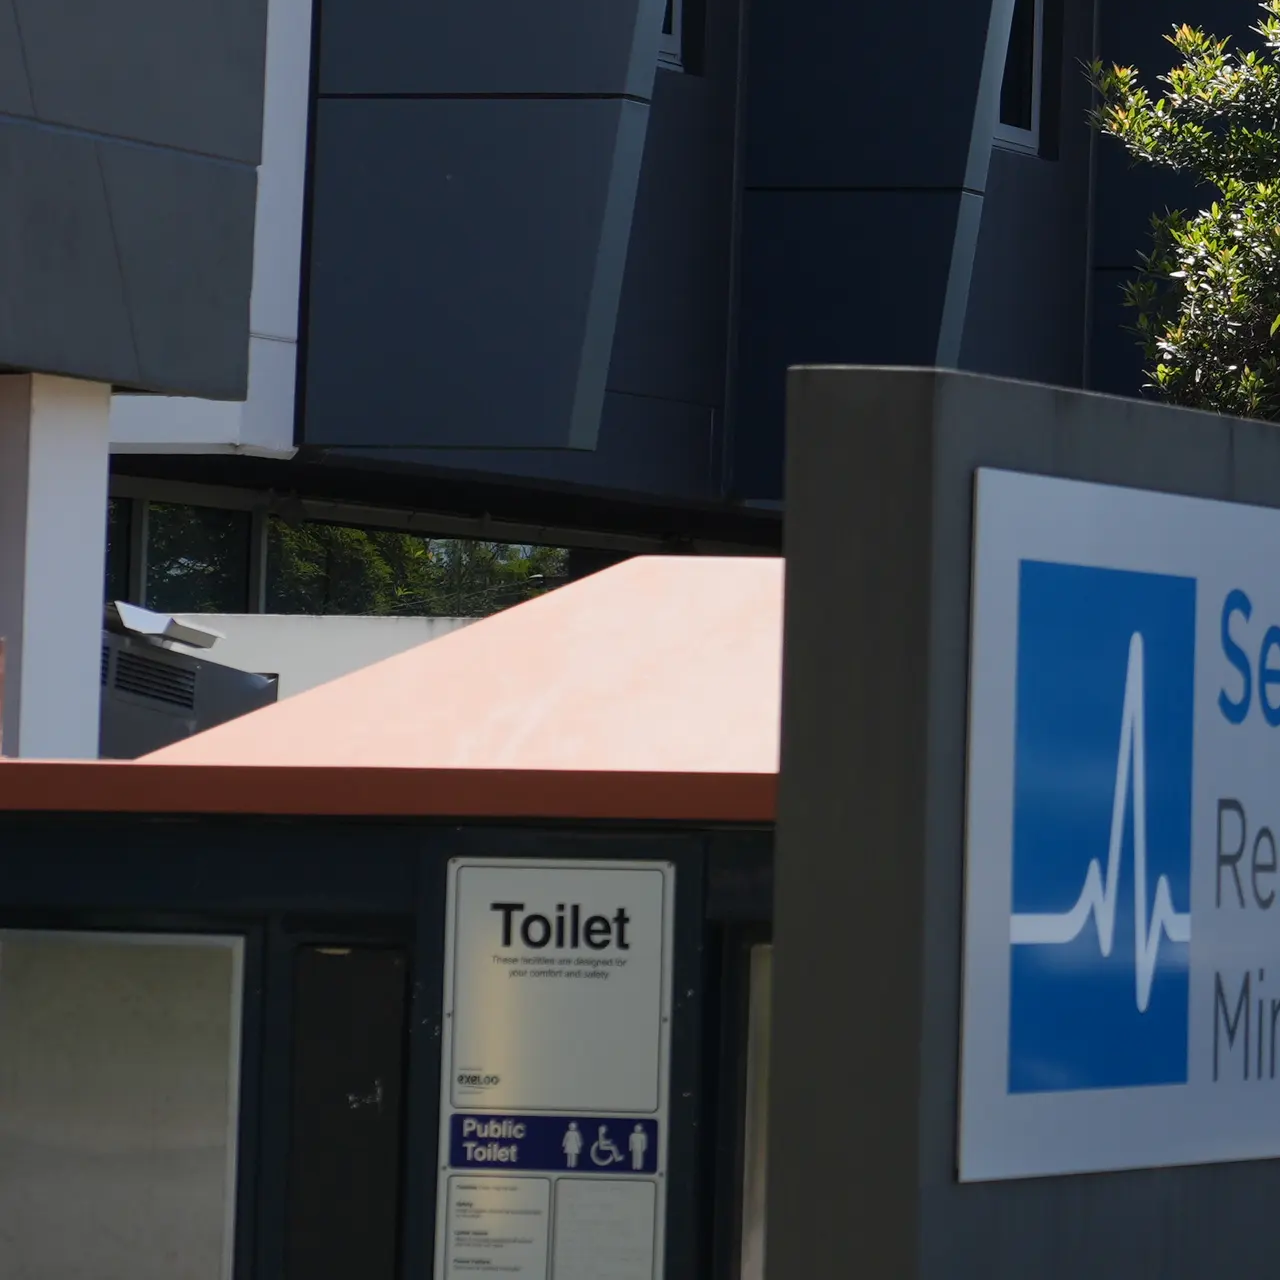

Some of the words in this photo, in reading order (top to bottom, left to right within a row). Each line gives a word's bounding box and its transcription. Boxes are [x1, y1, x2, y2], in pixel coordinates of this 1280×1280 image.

[489, 903, 630, 951] Toilet
[492, 955, 517, 966] These
[557, 958, 572, 967] are
[574, 957, 613, 969] designed
[508, 969, 527, 979] your
[529, 968, 562, 978] comfort
[564, 969, 581, 978] and
[584, 970, 609, 980] safety
[463, 1118, 525, 1139] Public
[462, 1142, 518, 1162] Toilet
